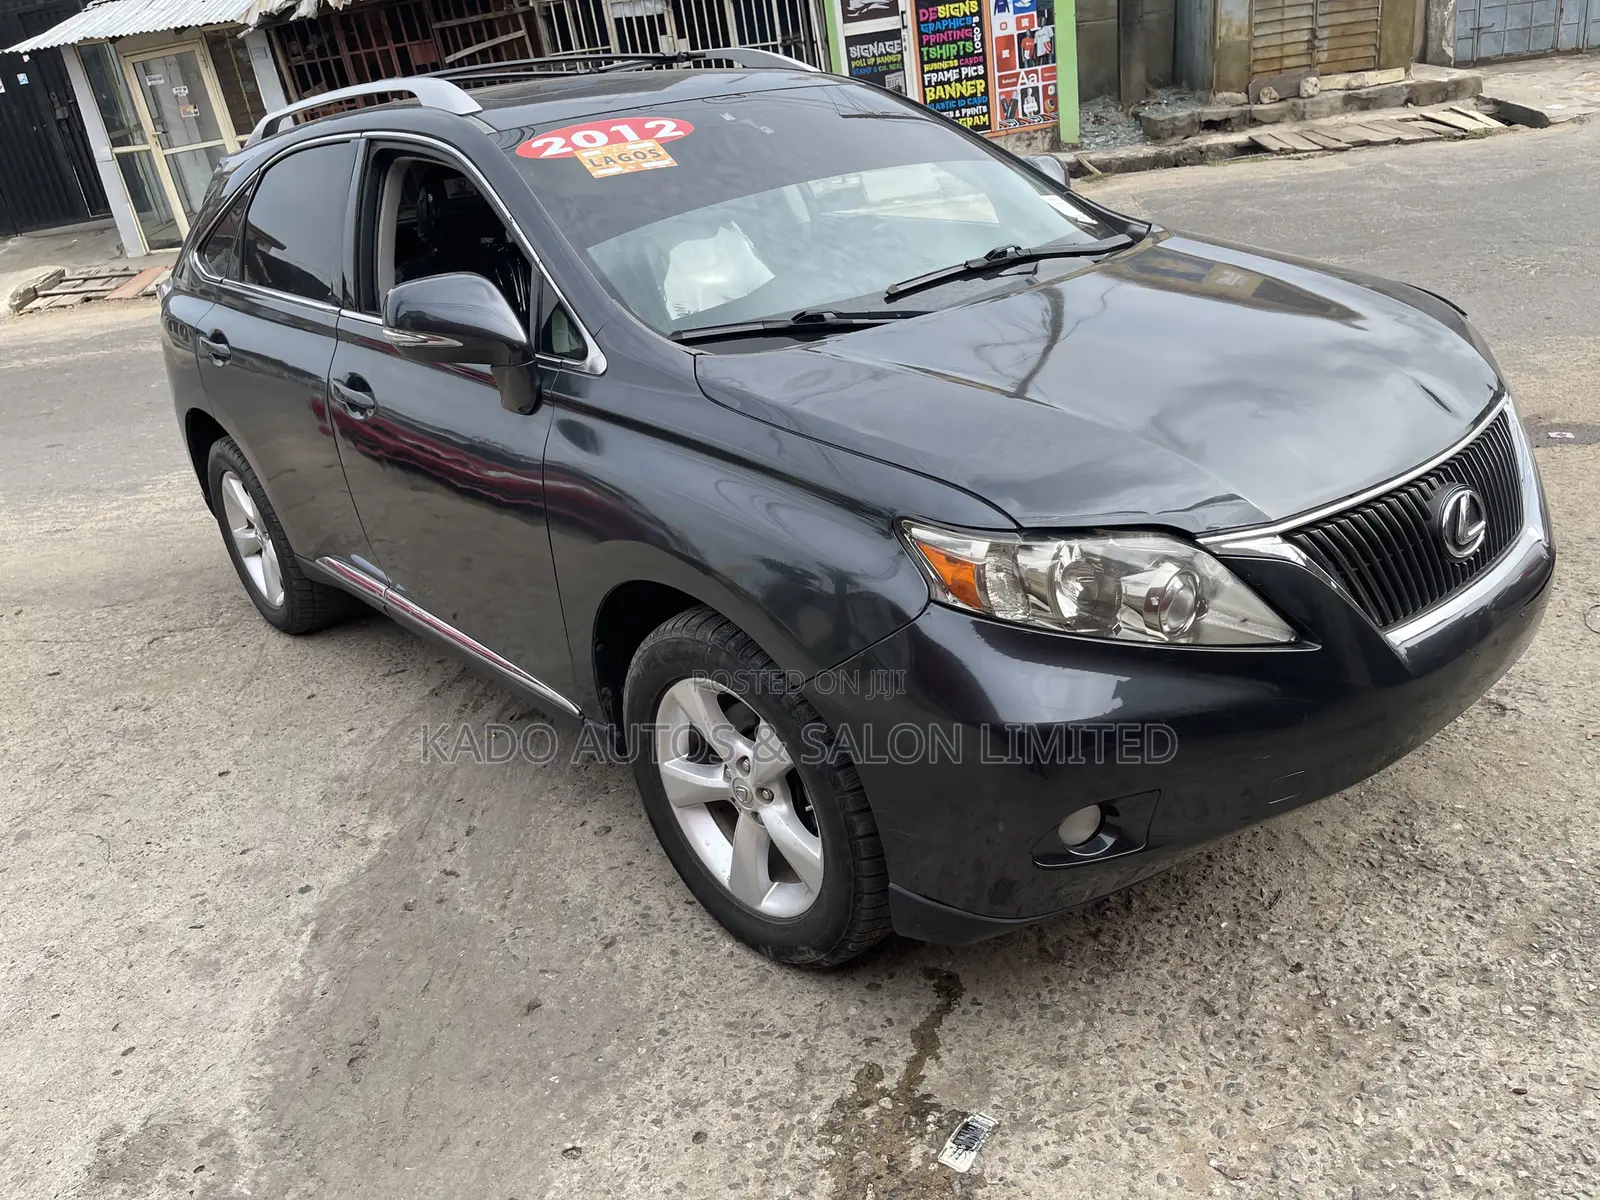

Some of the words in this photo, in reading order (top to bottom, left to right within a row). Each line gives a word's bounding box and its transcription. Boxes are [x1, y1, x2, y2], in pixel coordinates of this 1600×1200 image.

[919, 0, 979, 21] DESIGNS
[920, 16, 973, 34] GRAPHICS
[922, 28, 973, 45] PRINTING
[849, 39, 902, 58] SIGNAGE
[921, 41, 974, 61] TSHIRTS
[876, 54, 902, 65] BANNER
[924, 60, 958, 72] BUSINESS
[960, 56, 984, 66] CARDS
[924, 69, 959, 86] FRAME
[961, 65, 985, 79] PICS
[1018, 70, 1037, 86] Aa
[925, 79, 986, 103] BANNER
[958, 98, 966, 107] ID
[967, 95, 988, 105] CARD
[961, 105, 988, 117] PRINTS
[531, 120, 684, 157] 2012
[588, 149, 662, 167] LAGOS
